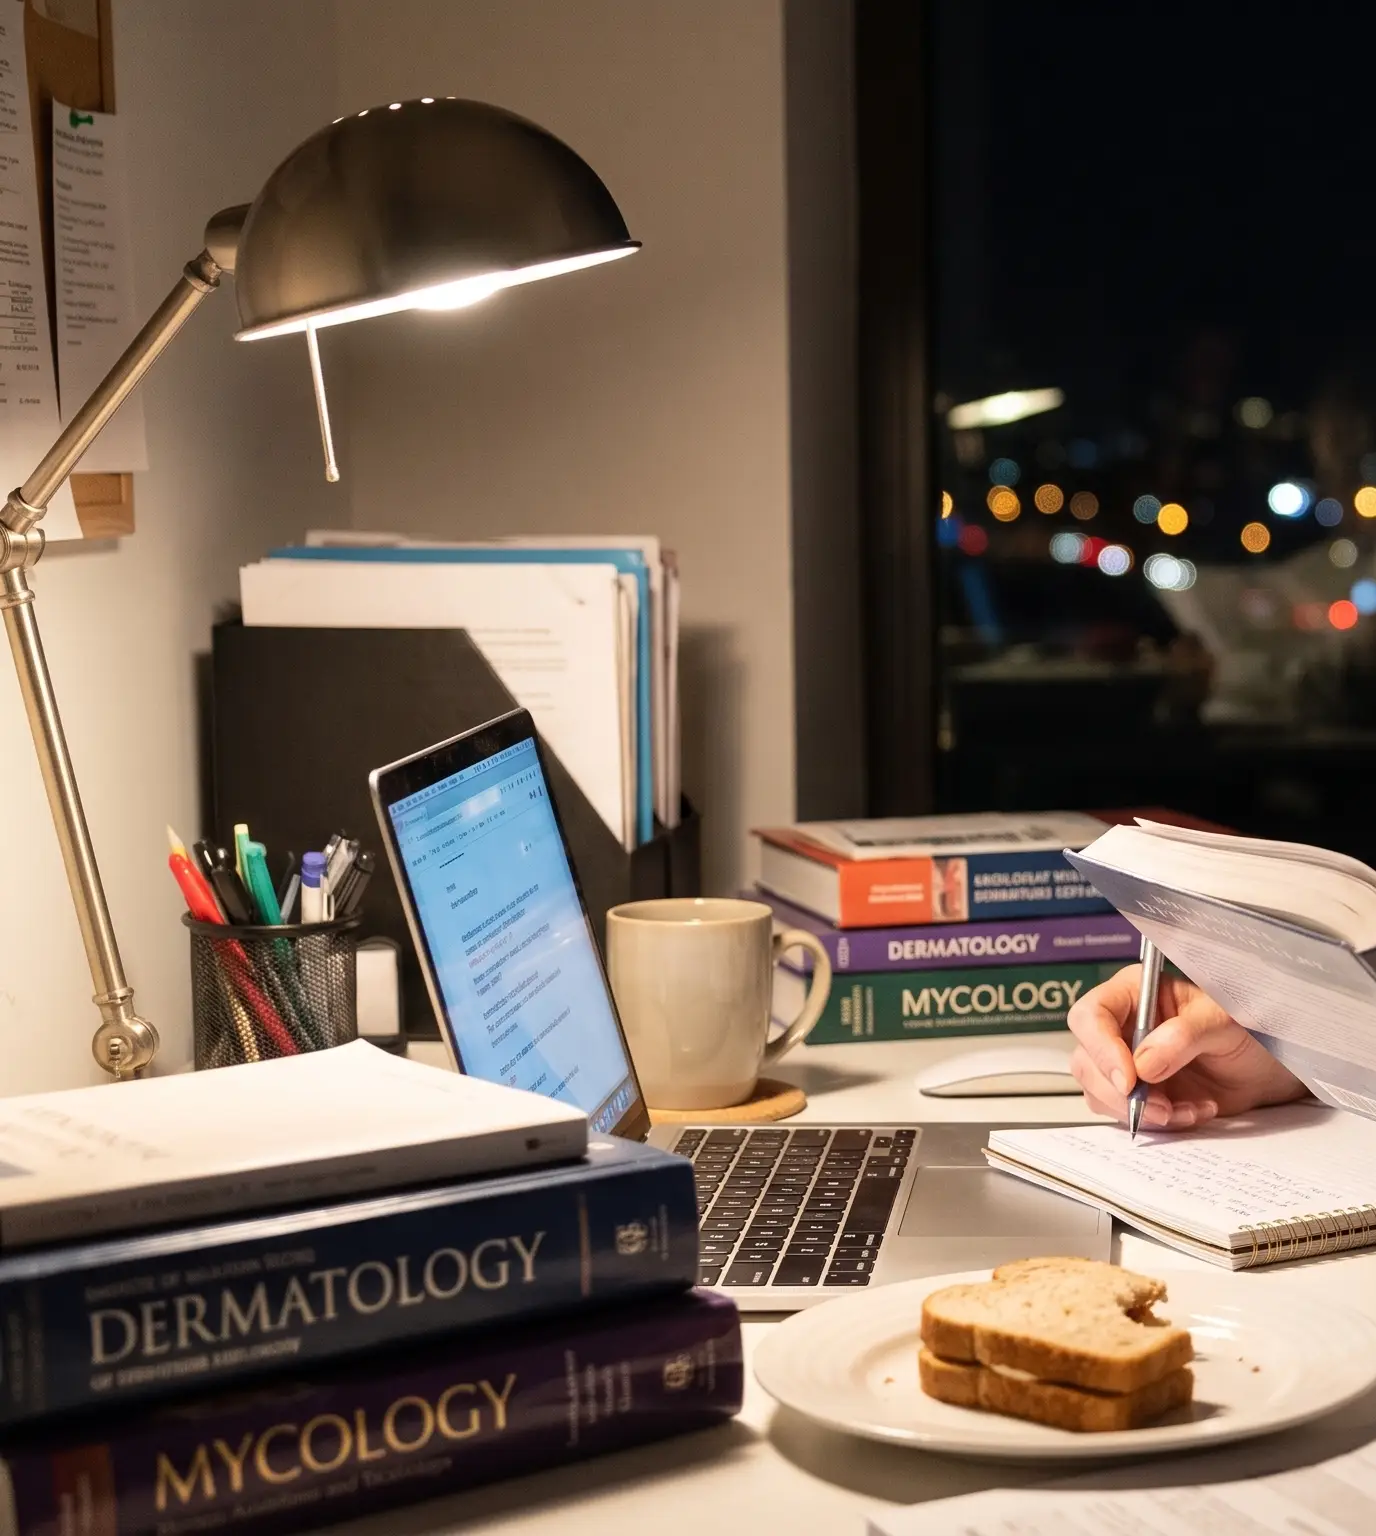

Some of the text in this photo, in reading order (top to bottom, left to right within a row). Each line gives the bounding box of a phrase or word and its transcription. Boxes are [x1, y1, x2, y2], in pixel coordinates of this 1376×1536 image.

[888, 933, 1040, 961] DERMATOLOGY
[902, 979, 1083, 1017] MYCOLOGY
[89, 1231, 546, 1366] DERMATOLOGY
[155, 1373, 518, 1511] MYCOLOGY
